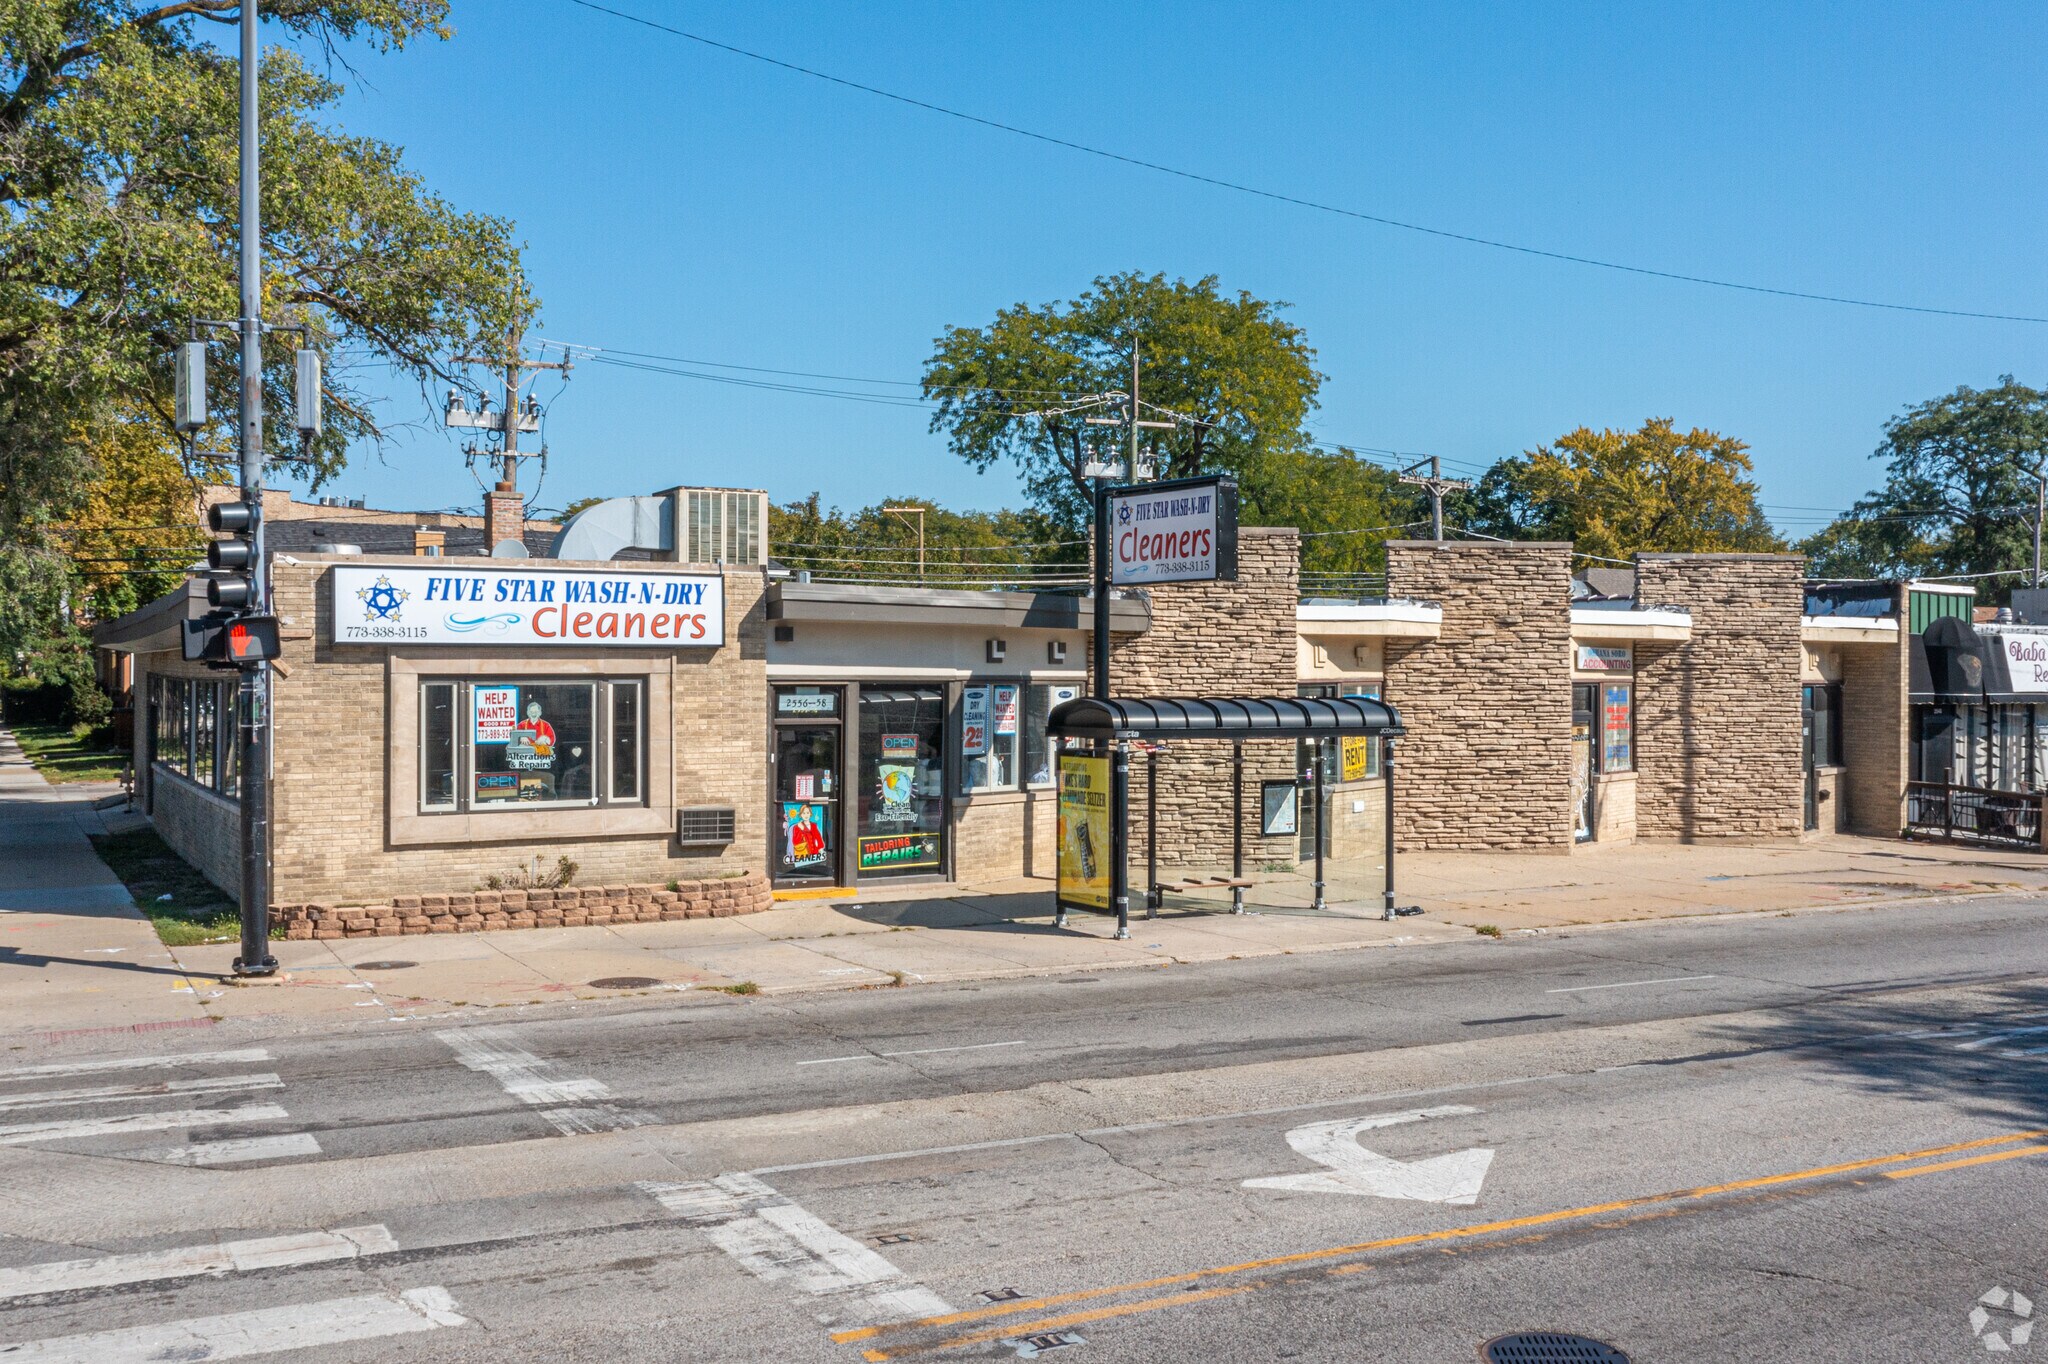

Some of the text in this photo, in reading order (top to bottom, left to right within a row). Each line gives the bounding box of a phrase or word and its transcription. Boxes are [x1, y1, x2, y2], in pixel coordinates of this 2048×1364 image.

[1136, 495, 1212, 521] FIVE STAR WASH-N-DRY
[1119, 527, 1211, 563] Cleaners
[1156, 560, 1210, 575] 773-338-3115
[424, 577, 708, 606] FIVE STAR WASH-N-DRY
[532, 603, 706, 639] Cleaners
[346, 626, 428, 638] 773-338-3115
[2009, 641, 2046, 661] Baba
[1583, 659, 1631, 669] ACCOUNTING
[485, 692, 508, 705] HELP
[999, 691, 1012, 702] HELP
[786, 698, 827, 708] 2556-58
[970, 701, 980, 710] DRY
[995, 703, 1015, 714] WANTED
[478, 706, 516, 719] WANTED
[964, 711, 987, 721] CLEANING
[883, 738, 917, 748] OPEN
[507, 752, 556, 760] Alterations
[1345, 746, 1365, 768] RENT
[519, 761, 551, 769] Repairs
[478, 776, 517, 787] OPEN
[865, 837, 911, 853] TAILORING
[784, 853, 826, 863] CLEANERS
[863, 845, 922, 866] REPAIRS
